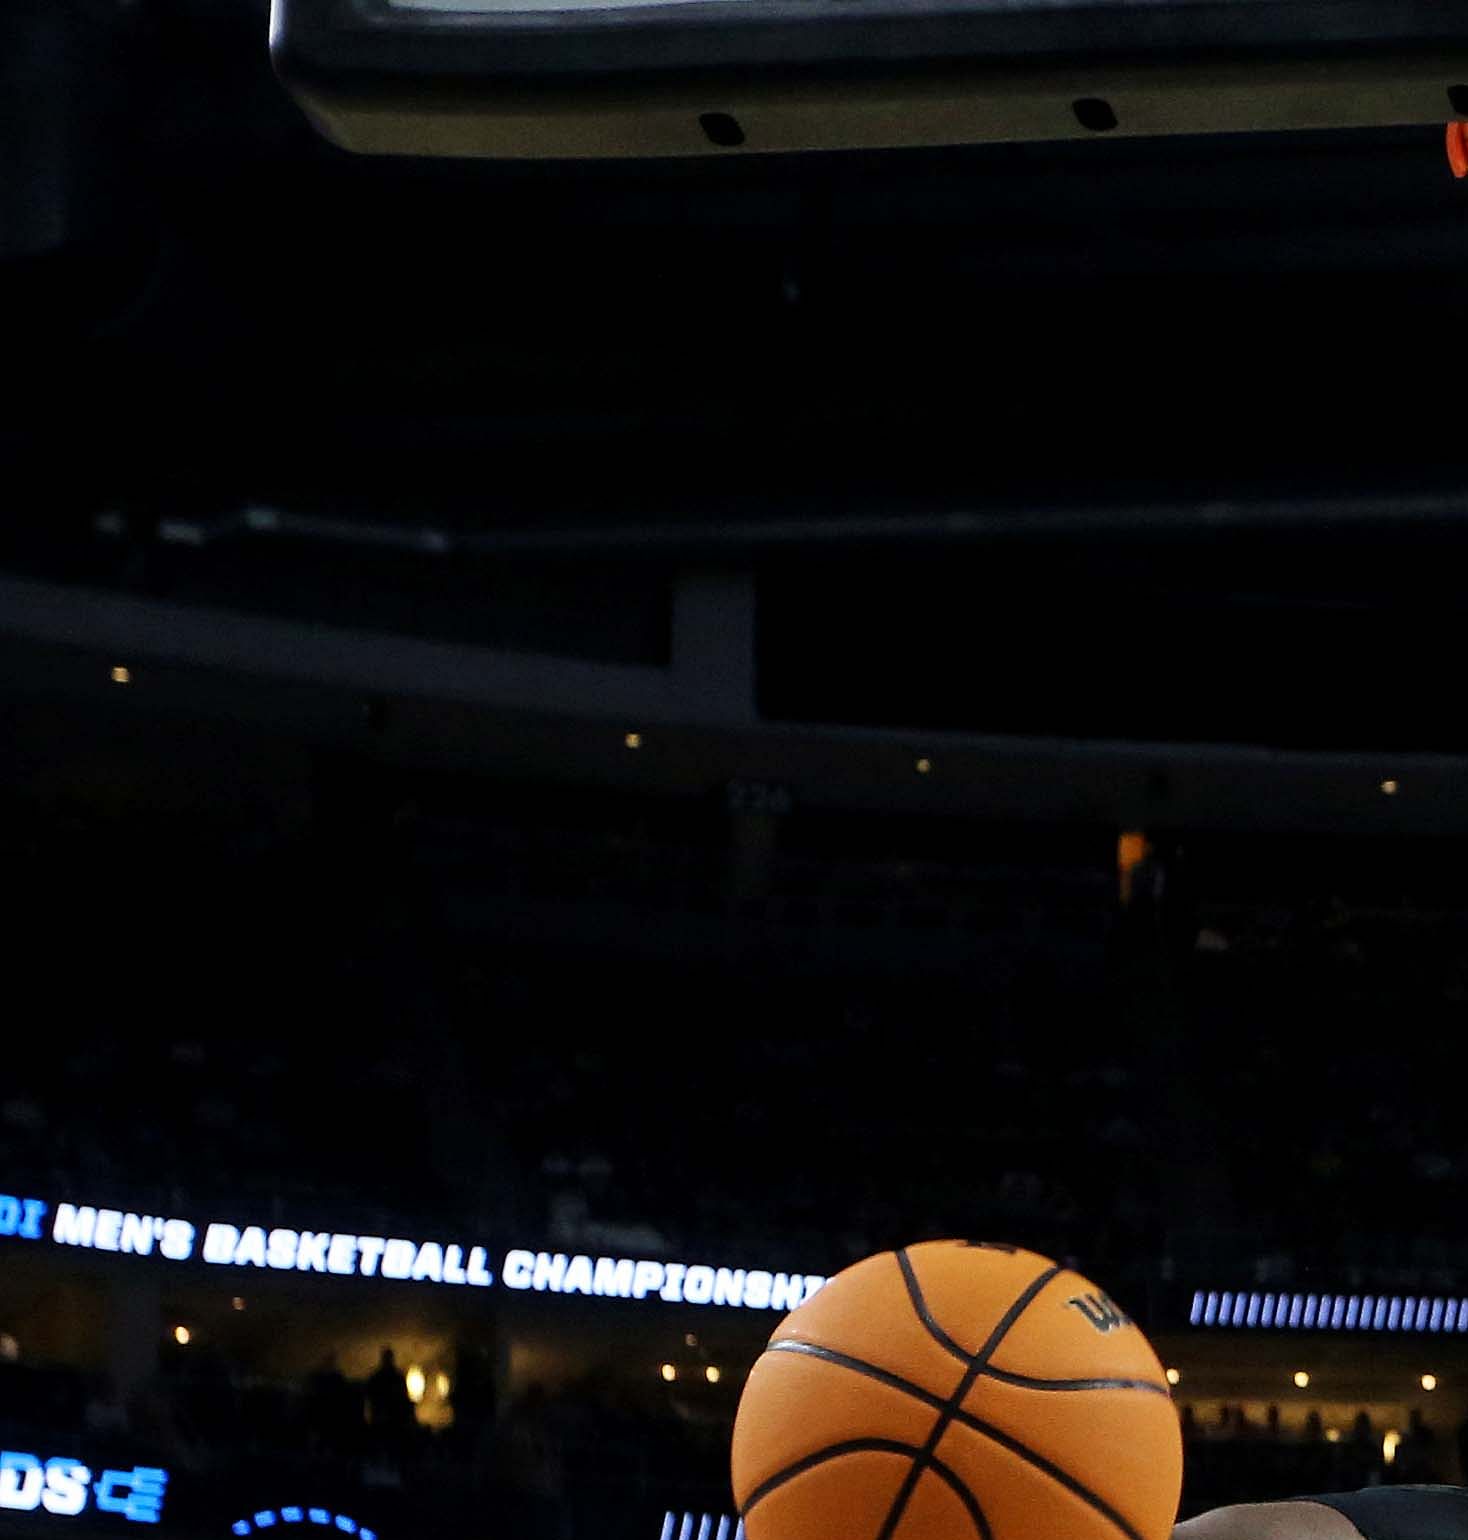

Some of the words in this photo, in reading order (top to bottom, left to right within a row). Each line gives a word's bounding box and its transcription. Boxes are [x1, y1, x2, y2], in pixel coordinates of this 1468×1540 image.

[0, 1194, 47, 1240] DI
[53, 1202, 196, 1261] MEN'S
[202, 1223, 493, 1287] BASKETBALL
[502, 1249, 836, 1311] CHAMPIONSHI
[0, 1450, 92, 1516] DS
